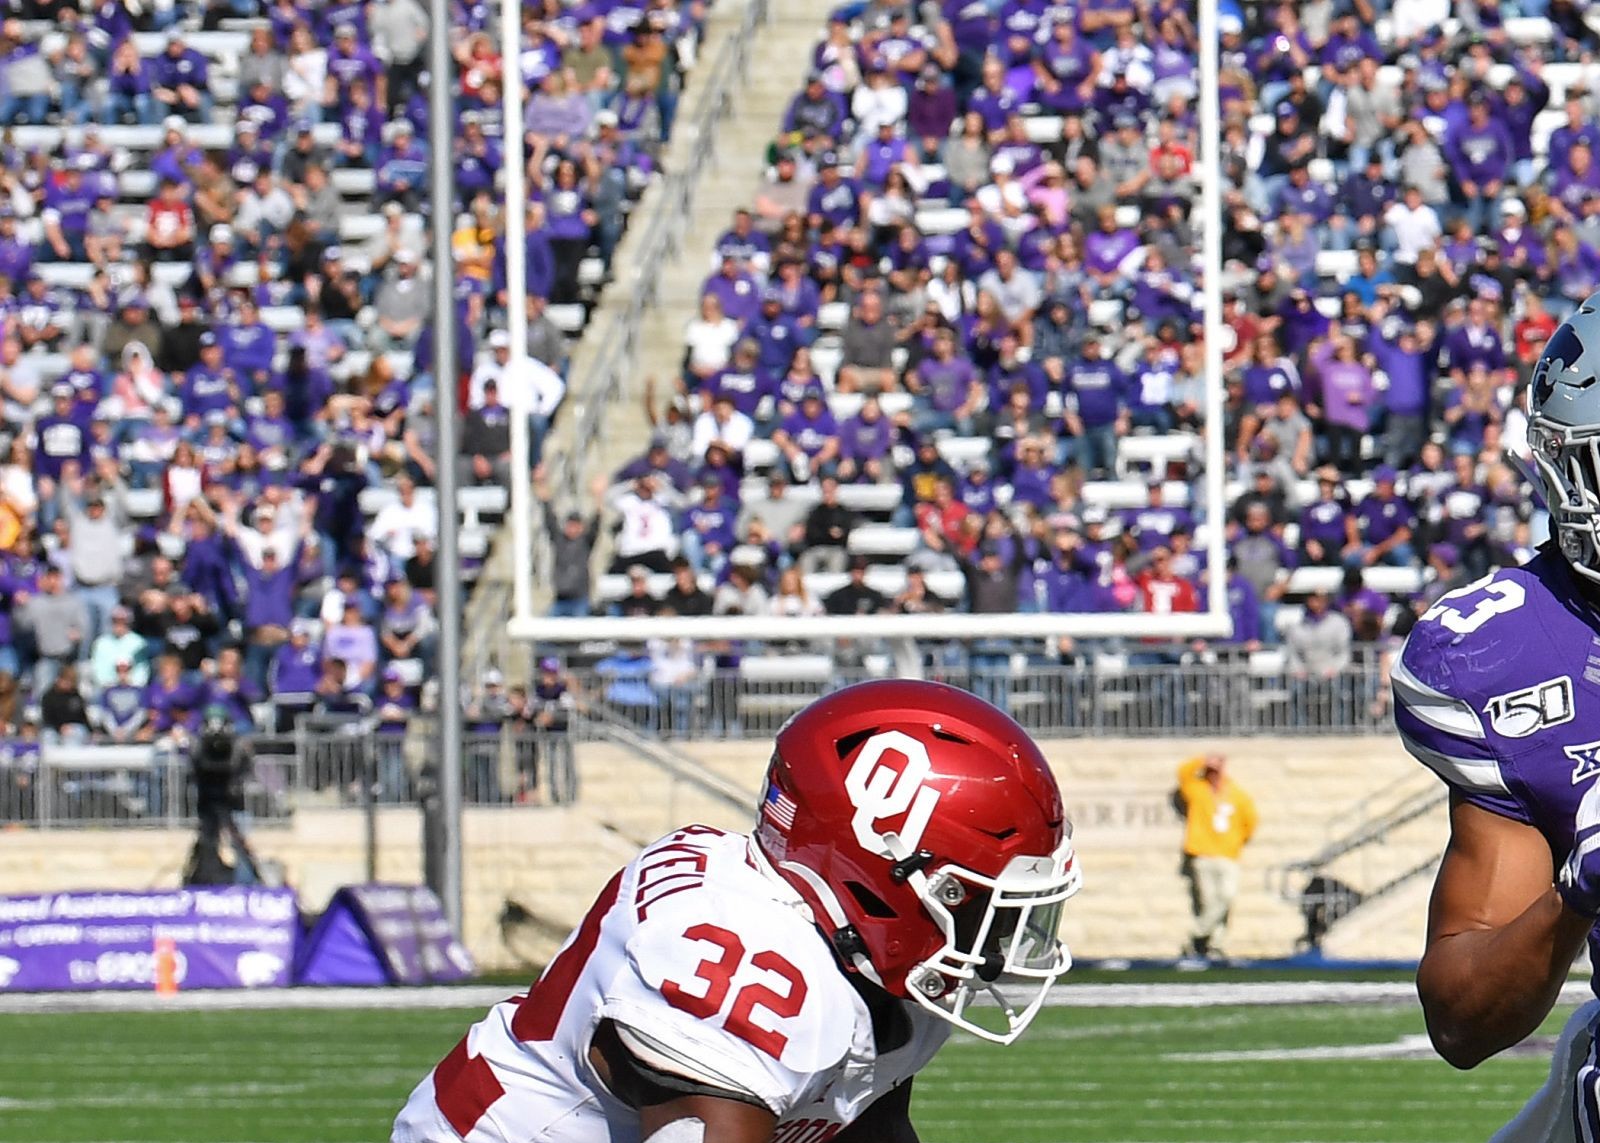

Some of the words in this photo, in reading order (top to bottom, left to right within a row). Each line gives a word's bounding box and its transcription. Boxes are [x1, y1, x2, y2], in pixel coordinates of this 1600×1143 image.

[1486, 678, 1572, 737] 150
[844, 729, 942, 861] OU
[659, 922, 809, 1061] 32
